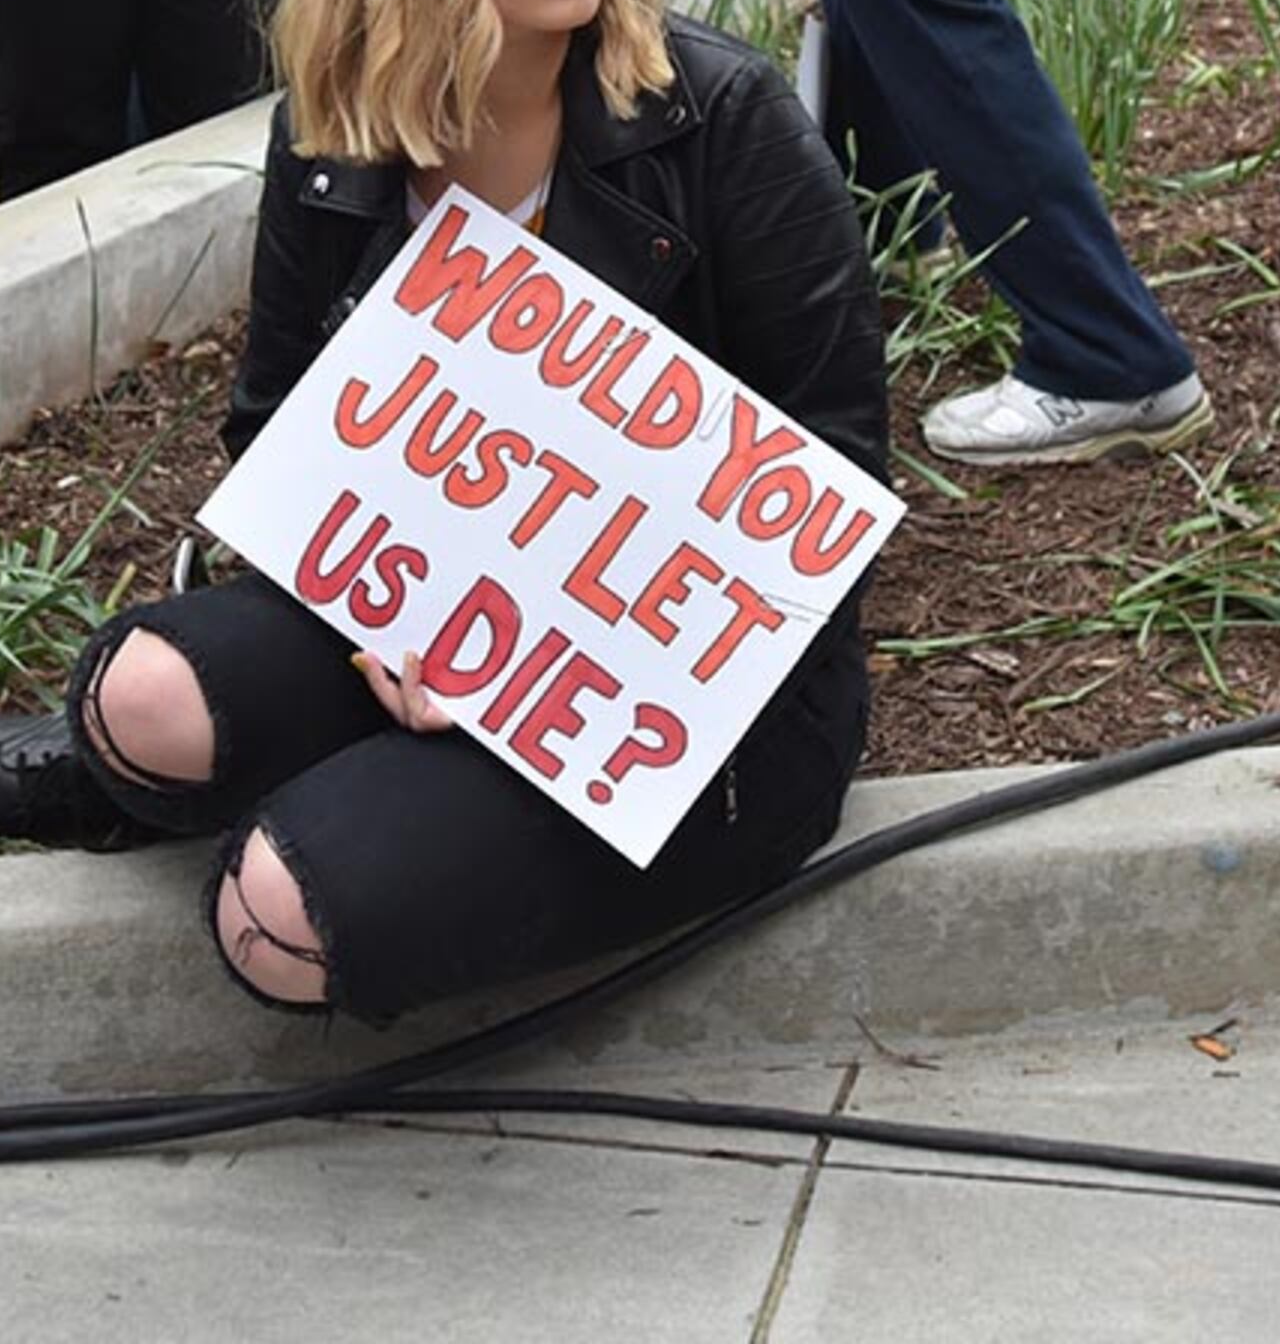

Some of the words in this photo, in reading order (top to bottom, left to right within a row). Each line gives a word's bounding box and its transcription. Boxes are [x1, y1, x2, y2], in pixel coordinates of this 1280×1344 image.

[334, 355, 601, 550] JUST
[561, 494, 788, 685] LET
[394, 203, 704, 452] WOULD
[695, 392, 876, 578] YOU
[294, 489, 430, 631] US
[417, 574, 690, 806] DIE?
